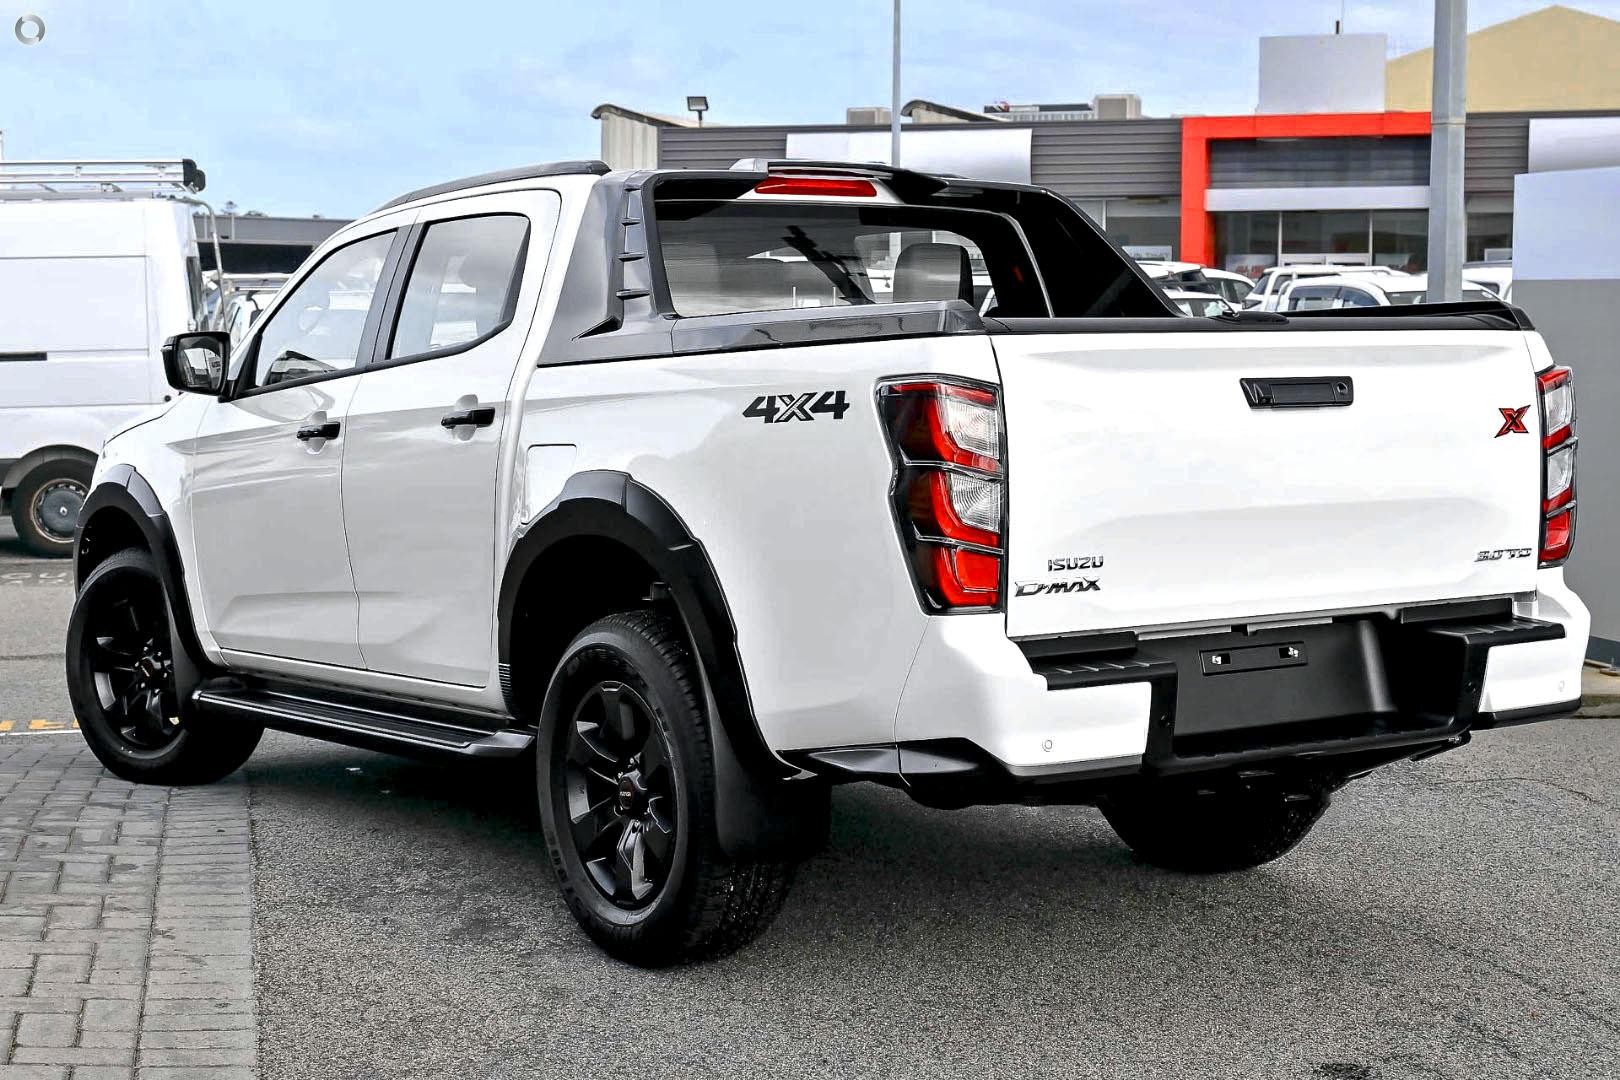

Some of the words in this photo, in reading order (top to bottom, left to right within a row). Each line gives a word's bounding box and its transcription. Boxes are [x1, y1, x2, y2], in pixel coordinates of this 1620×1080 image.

[742, 390, 850, 423] 4X4
[1494, 404, 1531, 438] X
[1047, 555, 1104, 572] ISUZU
[1014, 576, 1101, 597] D-MAX
